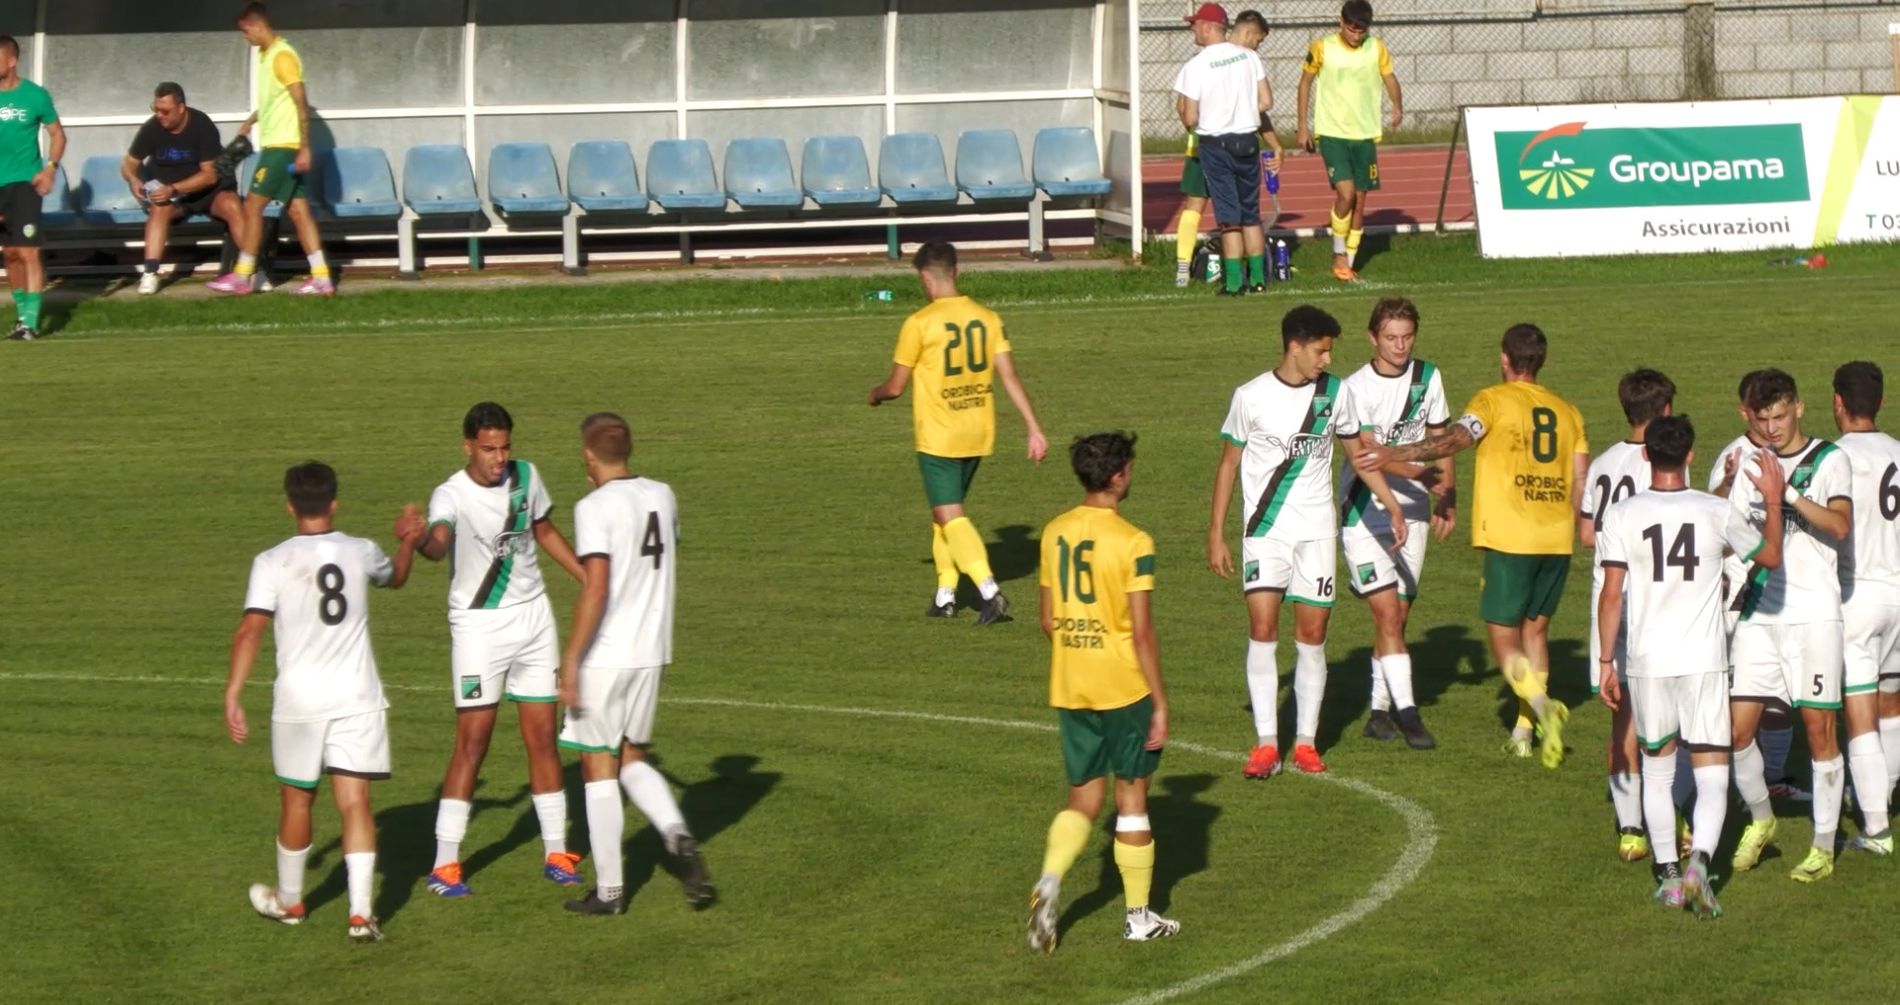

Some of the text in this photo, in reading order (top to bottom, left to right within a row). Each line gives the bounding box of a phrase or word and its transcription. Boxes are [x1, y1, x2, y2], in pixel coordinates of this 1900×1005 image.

[1609, 154, 1784, 187] Groupama
[1642, 216, 1791, 238] Assicurazioni
[1865, 214, 1877, 229] T
[944, 319, 987, 376] 20
[1532, 407, 1557, 463] 8
[1879, 461, 1900, 521] 6
[640, 511, 664, 570] 4
[1642, 523, 1700, 582] 14
[317, 563, 347, 626] 8
[1056, 535, 1097, 604] 16
[1316, 576, 1332, 597] 16
[1812, 674, 1824, 696] 5
